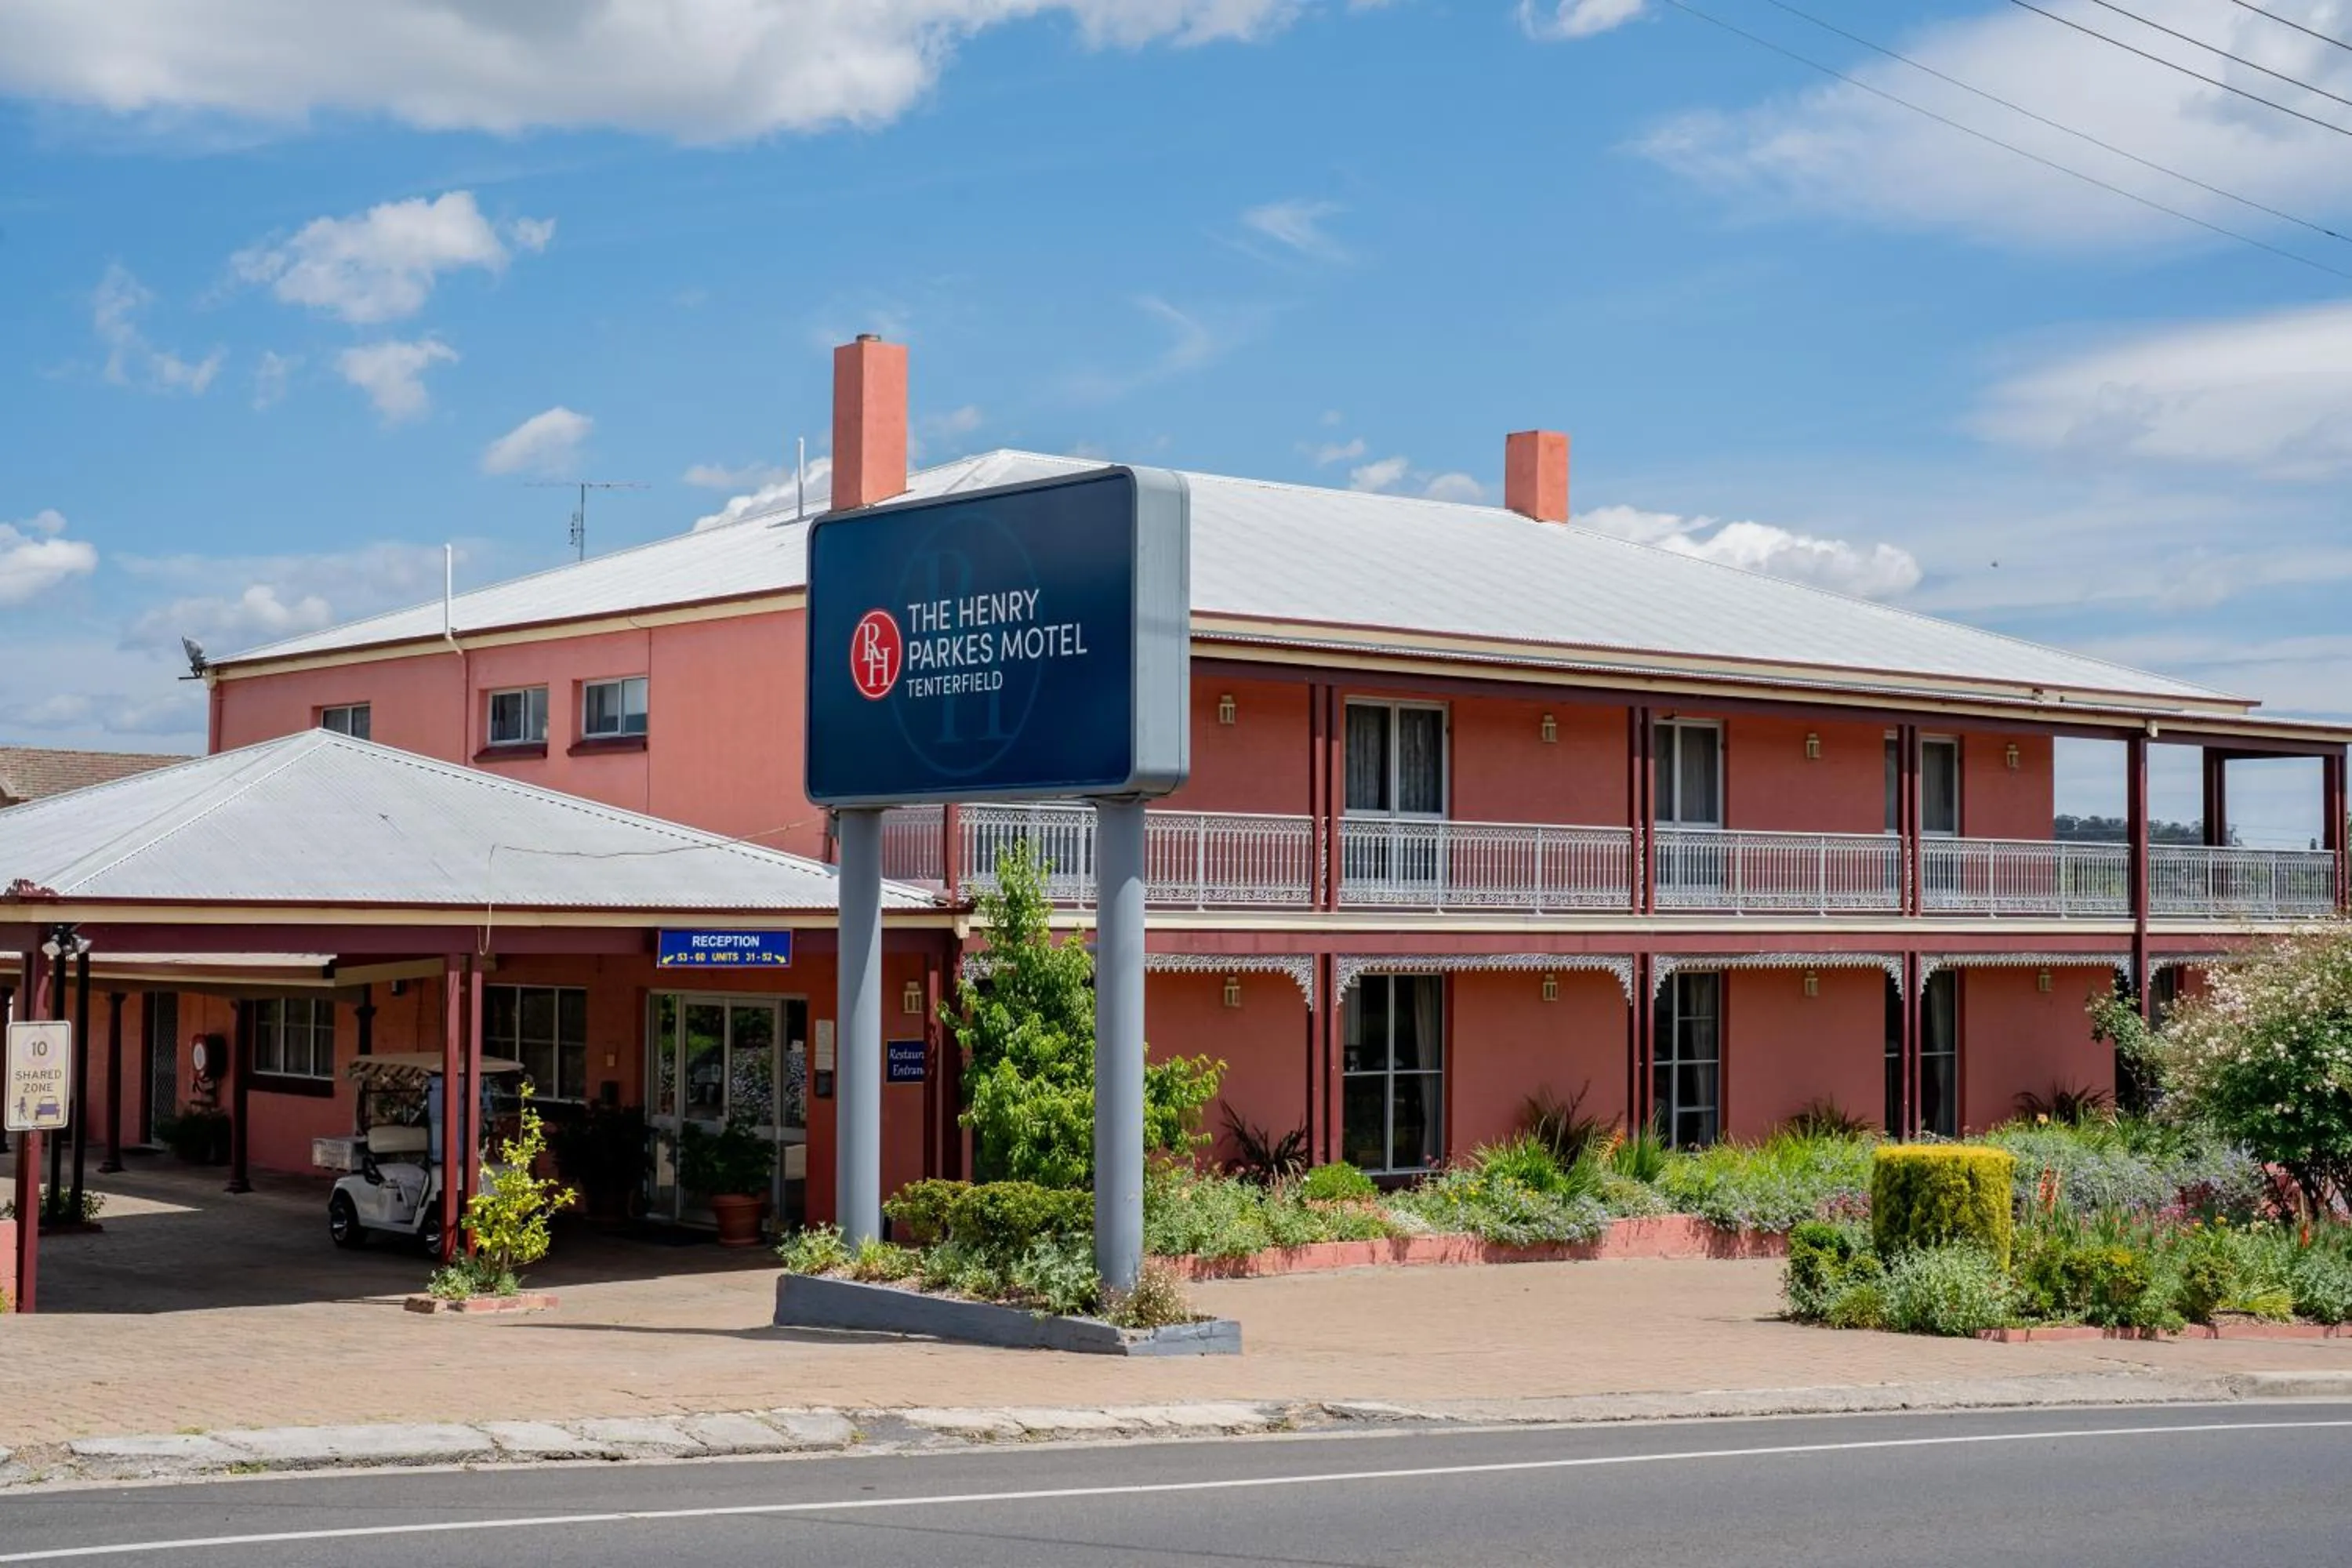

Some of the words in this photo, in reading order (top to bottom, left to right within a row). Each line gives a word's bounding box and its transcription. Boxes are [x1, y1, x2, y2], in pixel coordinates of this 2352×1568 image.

[907, 599, 950, 633] THE
[959, 589, 1040, 626] HENRY
[908, 632, 993, 671] PARKES
[1000, 623, 1087, 662] MOTEL
[906, 670, 1003, 699] TENTERFIELD
[692, 935, 760, 947] RECEPTION
[711, 953, 739, 962] UNITS
[31, 1041, 48, 1056] 10
[890, 1048, 924, 1060] Restaur
[15, 1069, 62, 1081] SHARED
[893, 1064, 924, 1076] Entran
[23, 1083, 54, 1094] ZONE
